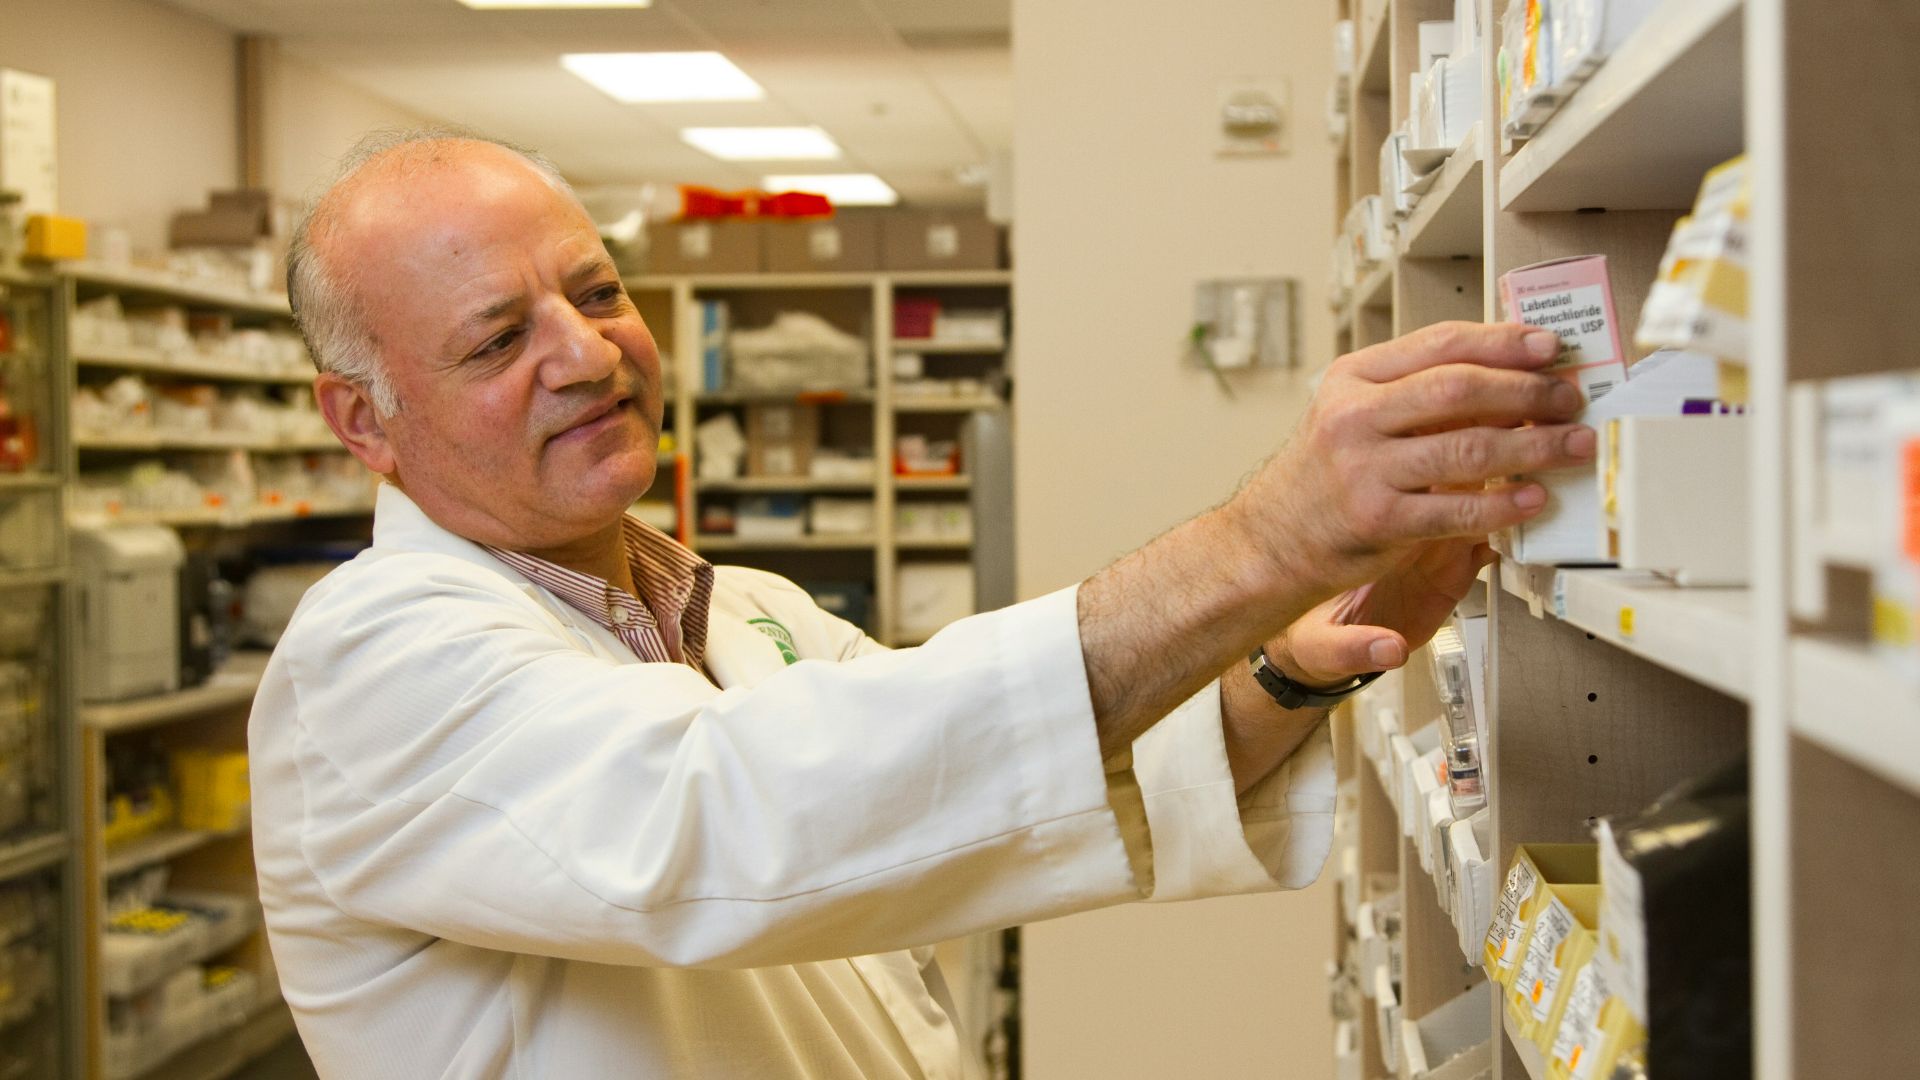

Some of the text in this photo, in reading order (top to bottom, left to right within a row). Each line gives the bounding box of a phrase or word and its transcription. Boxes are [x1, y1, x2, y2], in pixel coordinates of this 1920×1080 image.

[1521, 293, 1572, 312] Labetalol
[1524, 304, 1602, 326] Hydrochloride
[1581, 319, 1604, 334] USP
